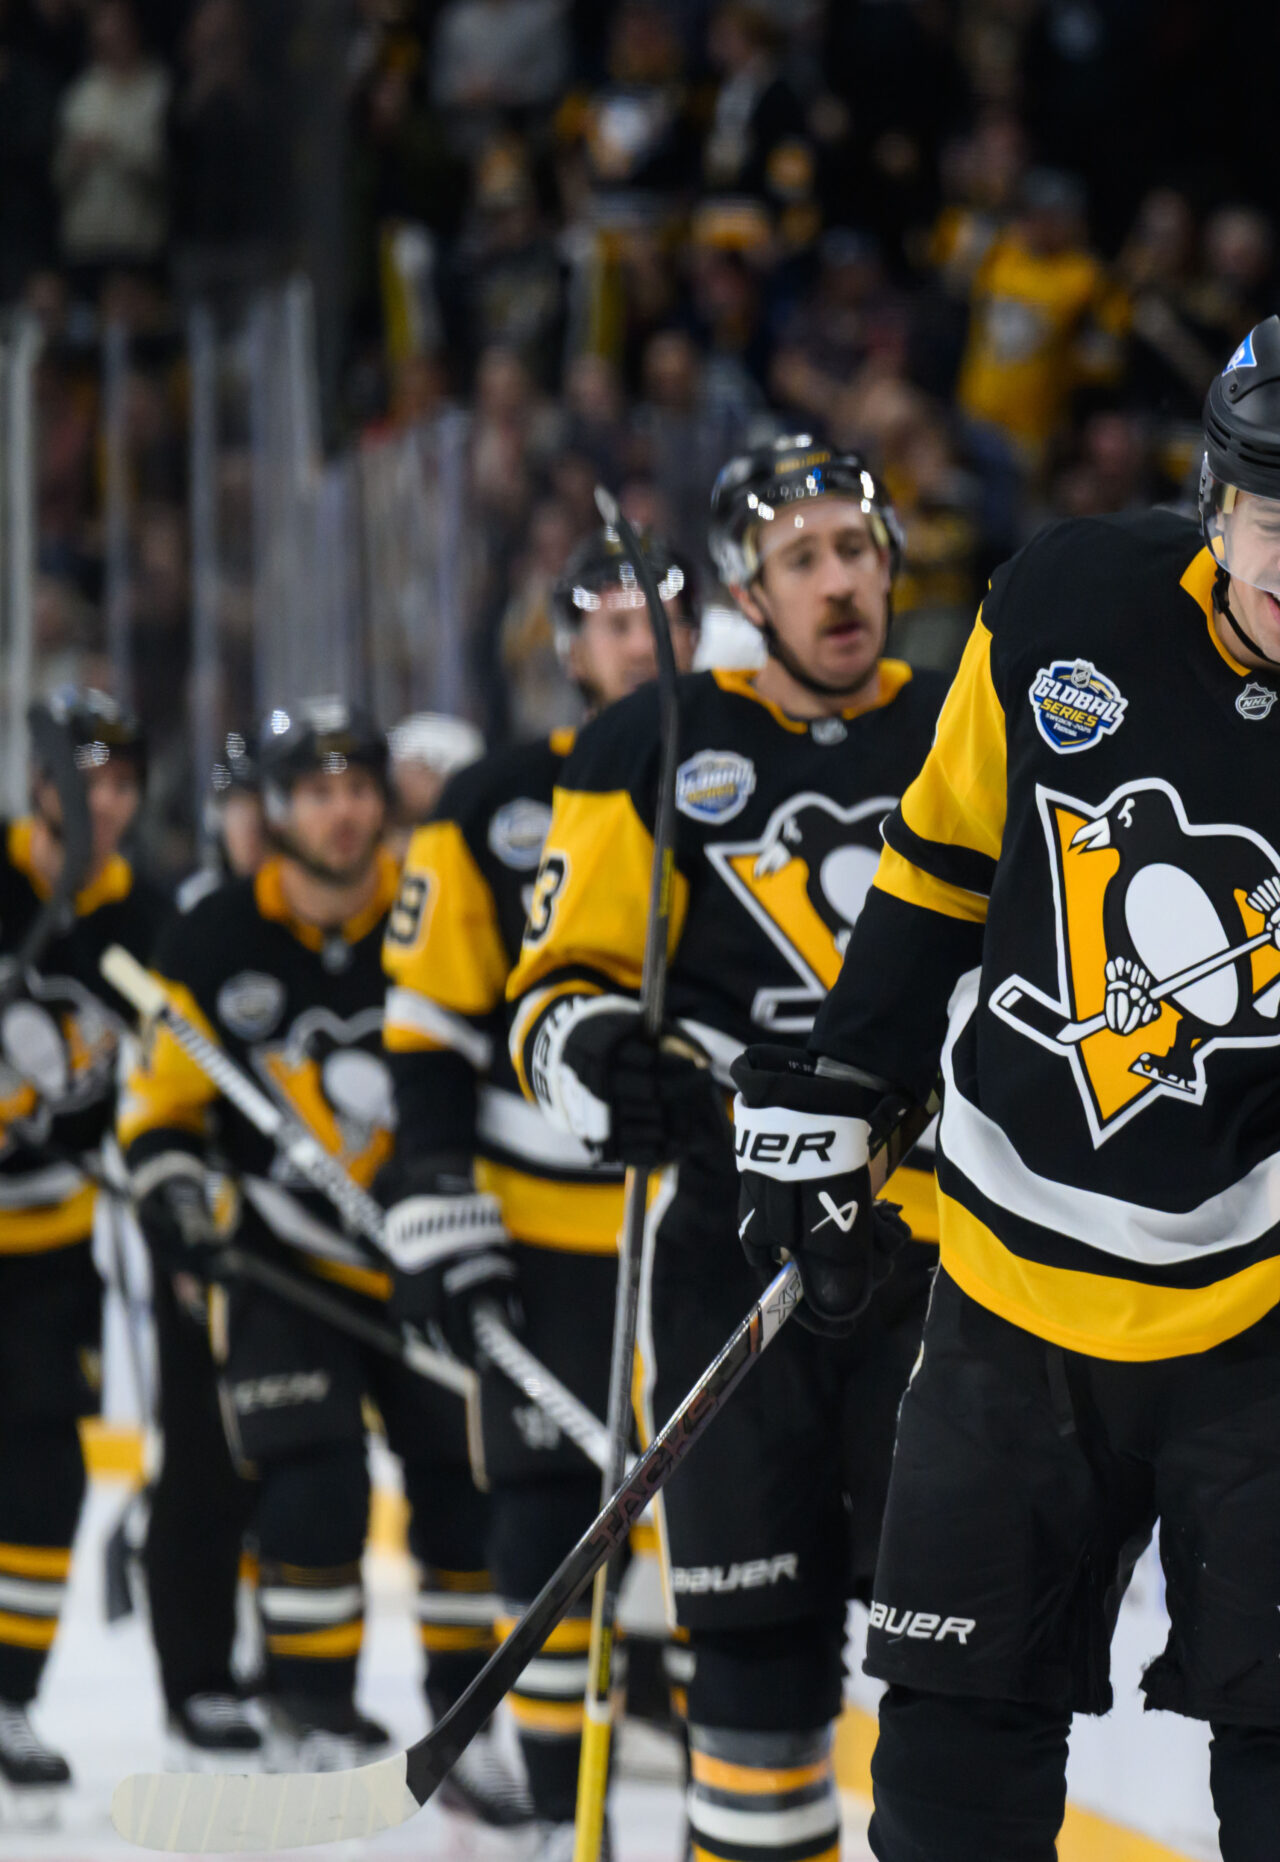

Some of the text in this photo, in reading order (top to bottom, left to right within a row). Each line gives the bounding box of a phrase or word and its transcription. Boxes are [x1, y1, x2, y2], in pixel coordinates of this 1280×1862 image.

[1034, 676, 1121, 722] GLOBAL
[1040, 698, 1099, 727] SERIES
[869, 1600, 976, 1645] AUER
